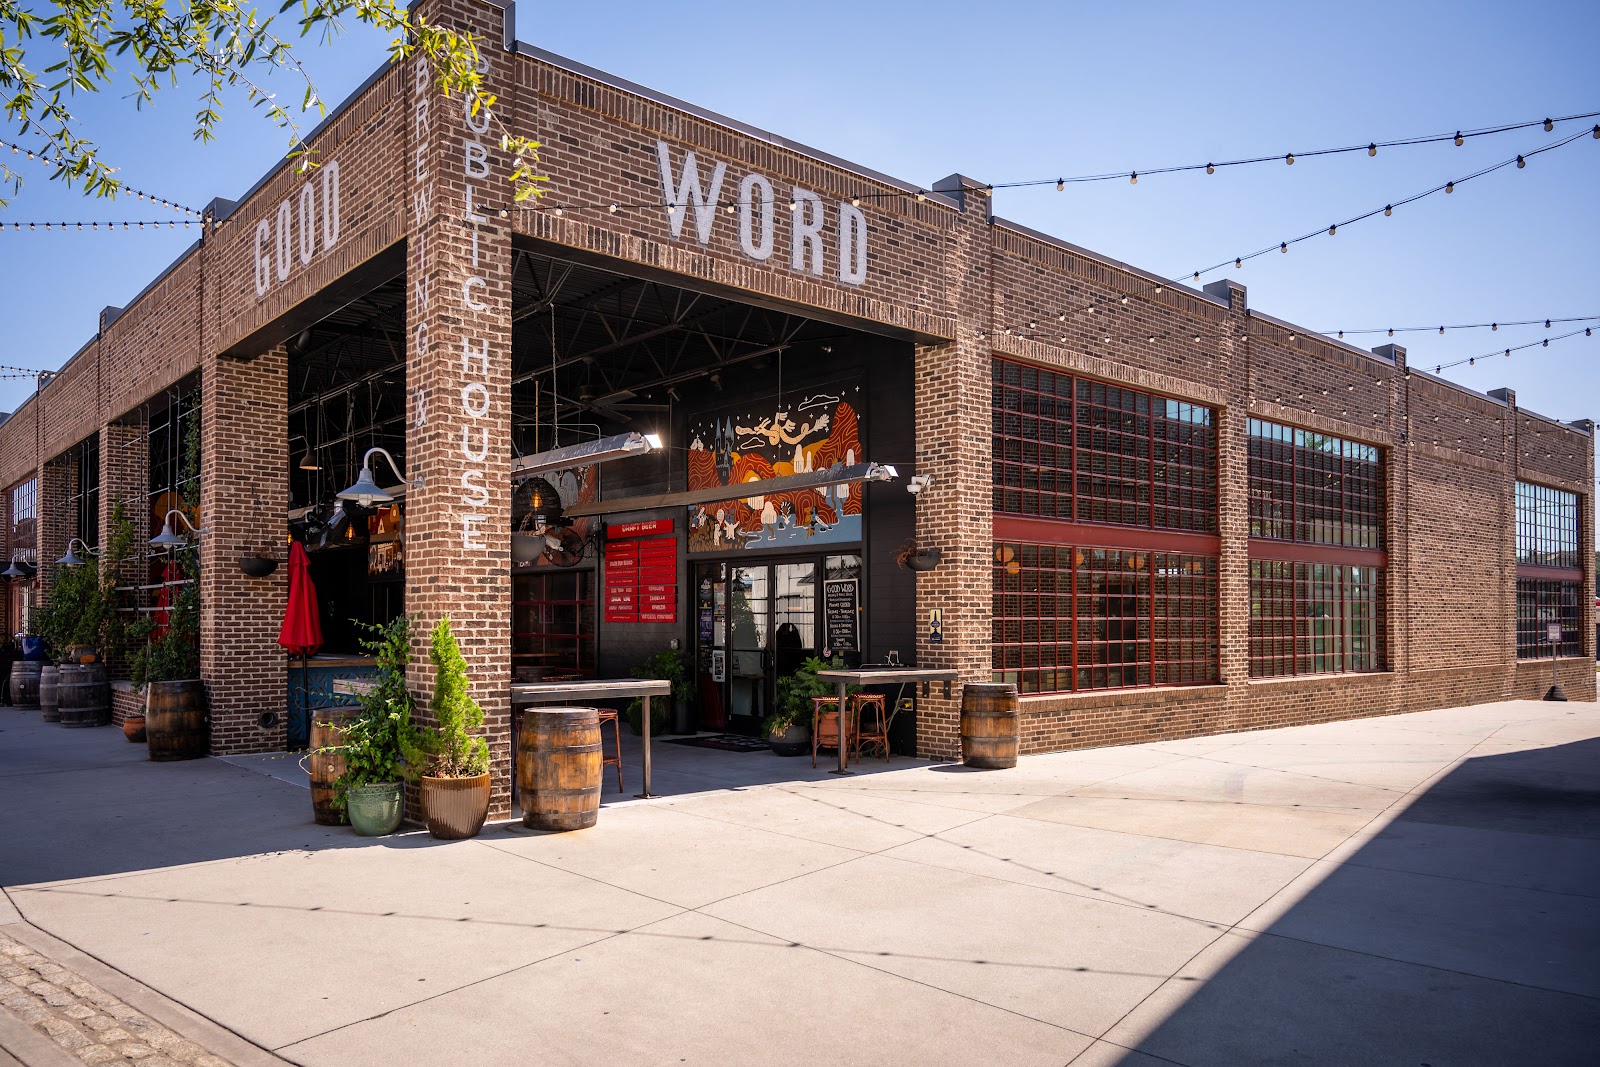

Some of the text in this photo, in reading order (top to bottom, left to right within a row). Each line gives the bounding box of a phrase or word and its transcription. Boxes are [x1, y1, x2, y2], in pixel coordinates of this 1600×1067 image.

[255, 158, 340, 297] GOOD
[414, 56, 432, 428] BREWING &
[461, 49, 491, 549] PUBLIC HOUSE
[656, 140, 868, 286] WORD
